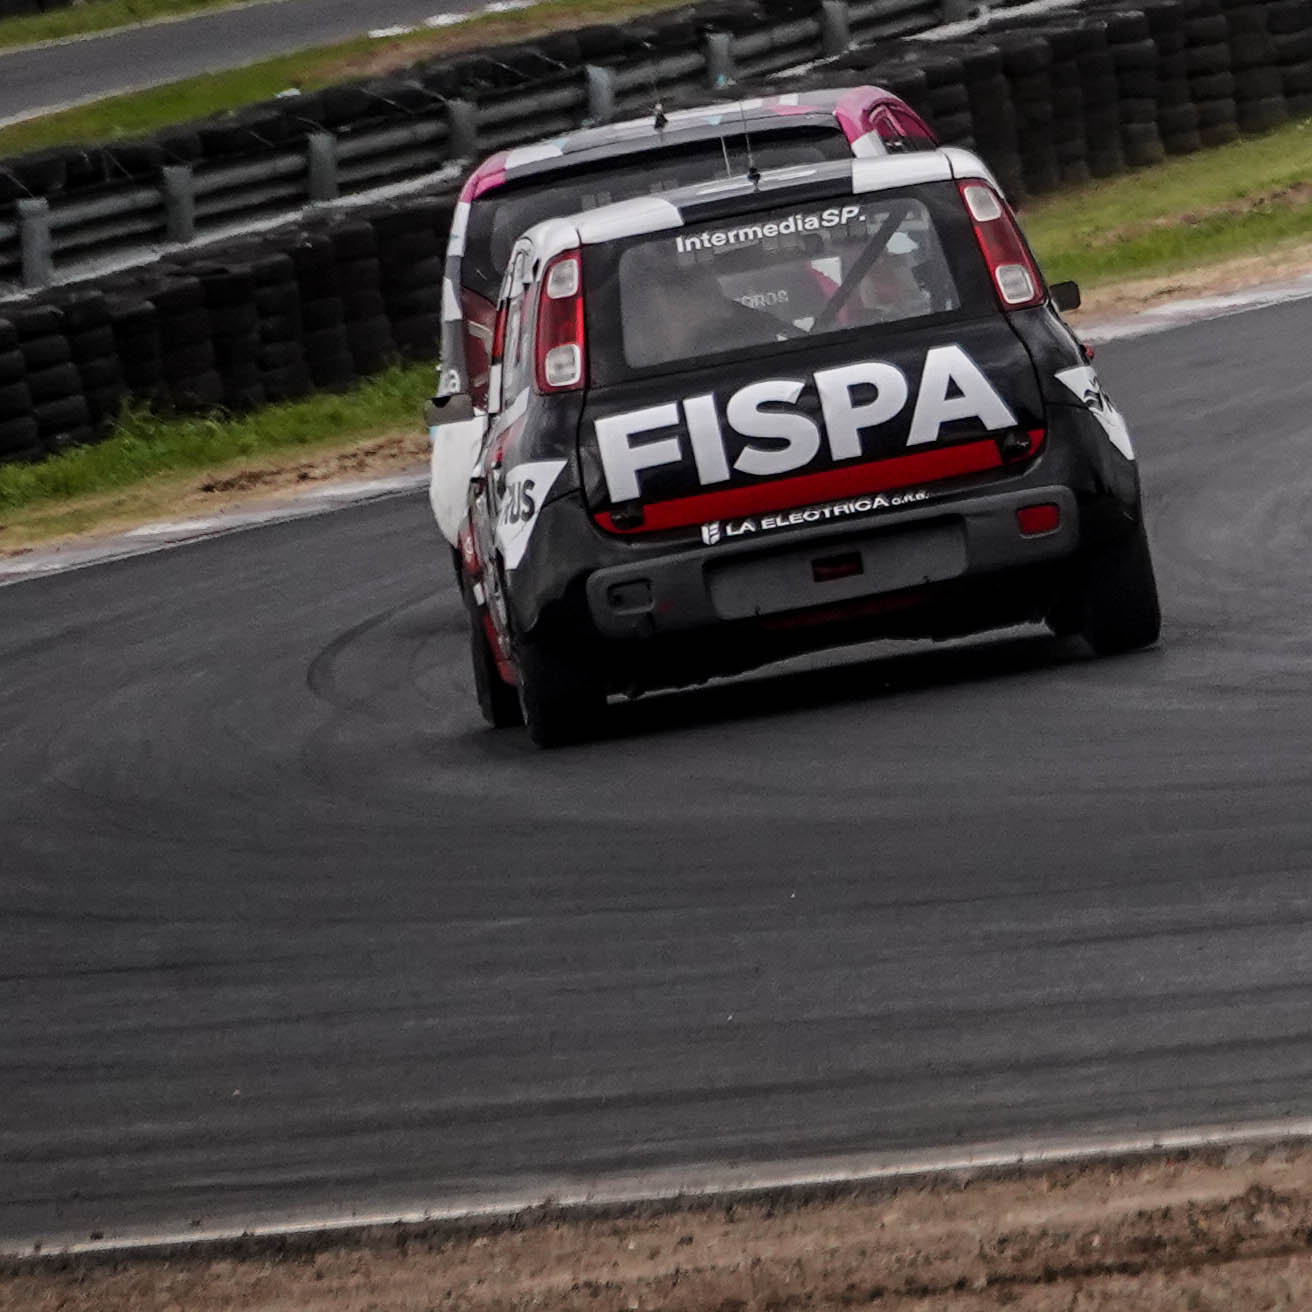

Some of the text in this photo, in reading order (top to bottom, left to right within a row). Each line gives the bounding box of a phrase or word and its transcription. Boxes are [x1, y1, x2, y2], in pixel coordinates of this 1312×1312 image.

[594, 344, 1017, 504] FISPA
[725, 521, 756, 537] LA
[761, 496, 889, 531] ELECTRICA
